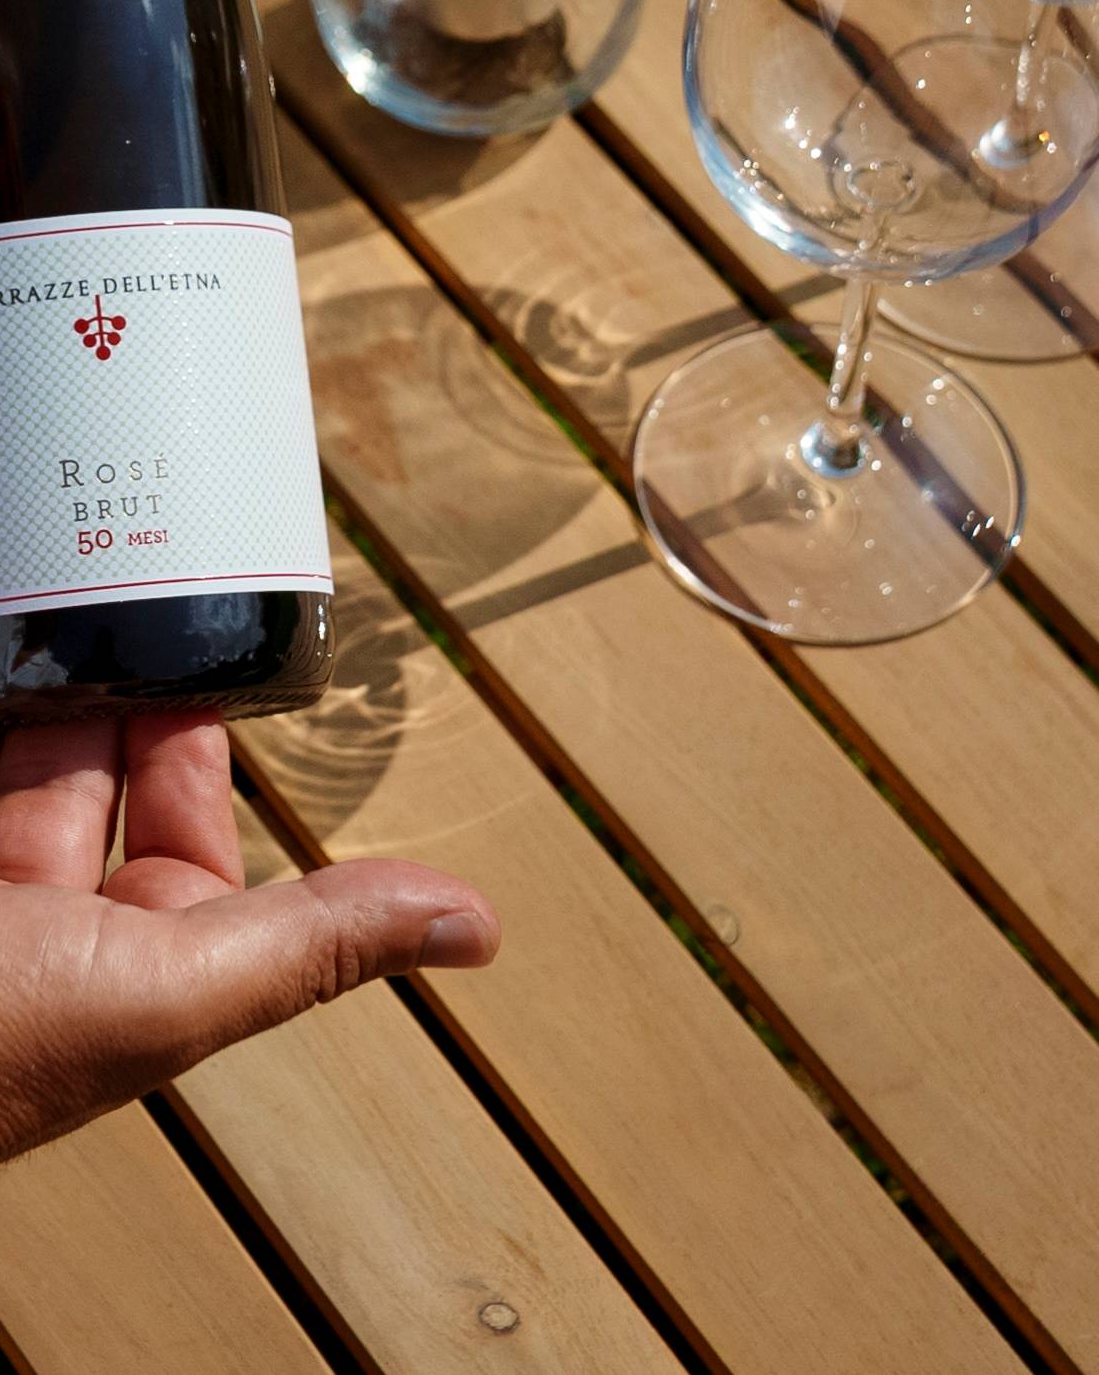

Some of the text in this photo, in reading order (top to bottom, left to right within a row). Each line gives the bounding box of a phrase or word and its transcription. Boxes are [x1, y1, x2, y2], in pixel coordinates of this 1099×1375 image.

[102, 273, 222, 295] DELL'ETNA
[58, 452, 169, 488] ROSÉ
[72, 494, 163, 522] BRUT
[77, 529, 170, 555] 50 MESI
